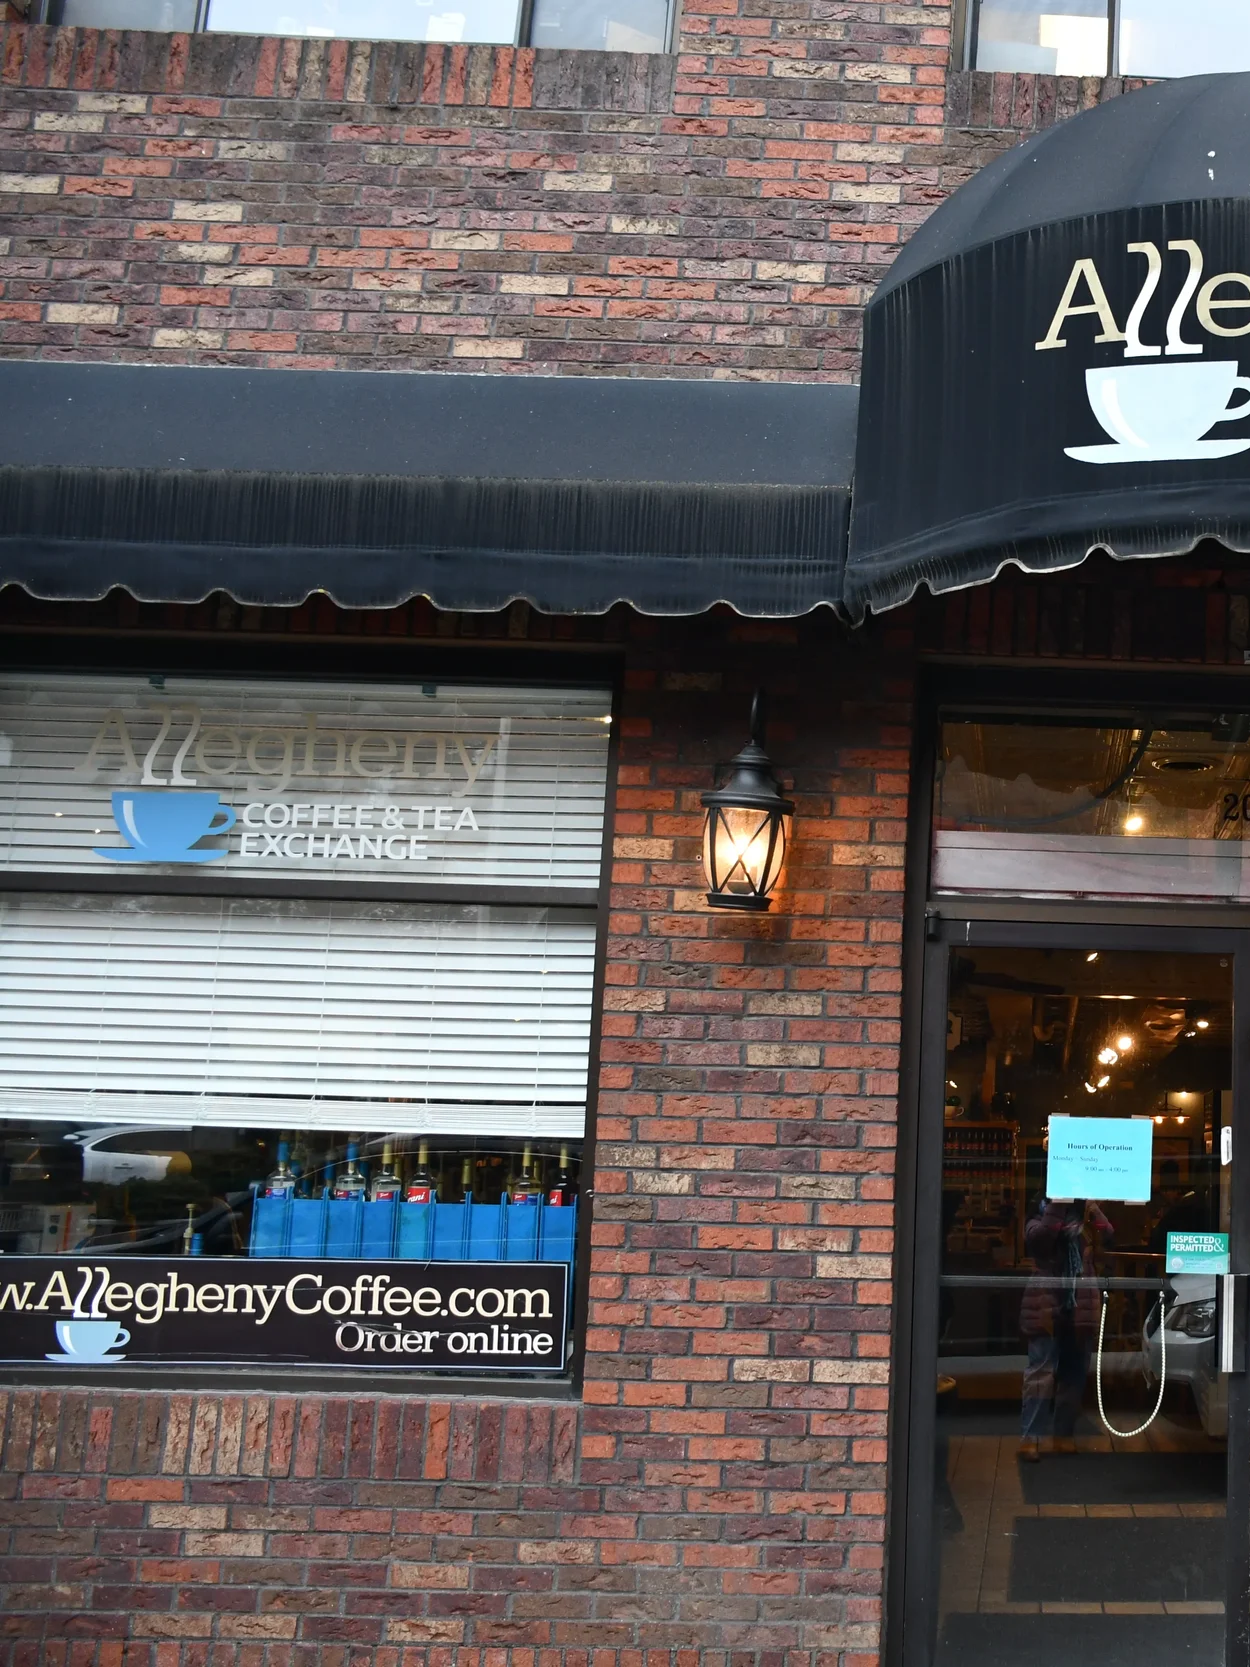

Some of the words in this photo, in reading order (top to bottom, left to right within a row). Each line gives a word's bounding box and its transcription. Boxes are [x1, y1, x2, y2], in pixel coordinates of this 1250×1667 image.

[73, 705, 499, 798] Allegheny
[242, 802, 375, 831] COFFEE
[381, 805, 404, 831] &
[417, 805, 480, 832] TEA
[240, 833, 429, 861] EXCHANGE
[1170, 1235, 1214, 1244] INSPECTED
[1213, 1238, 1224, 1252] &
[1170, 1243, 1213, 1252] PERMITTED
[336, 1322, 439, 1353] Order
[446, 1323, 553, 1354] online
